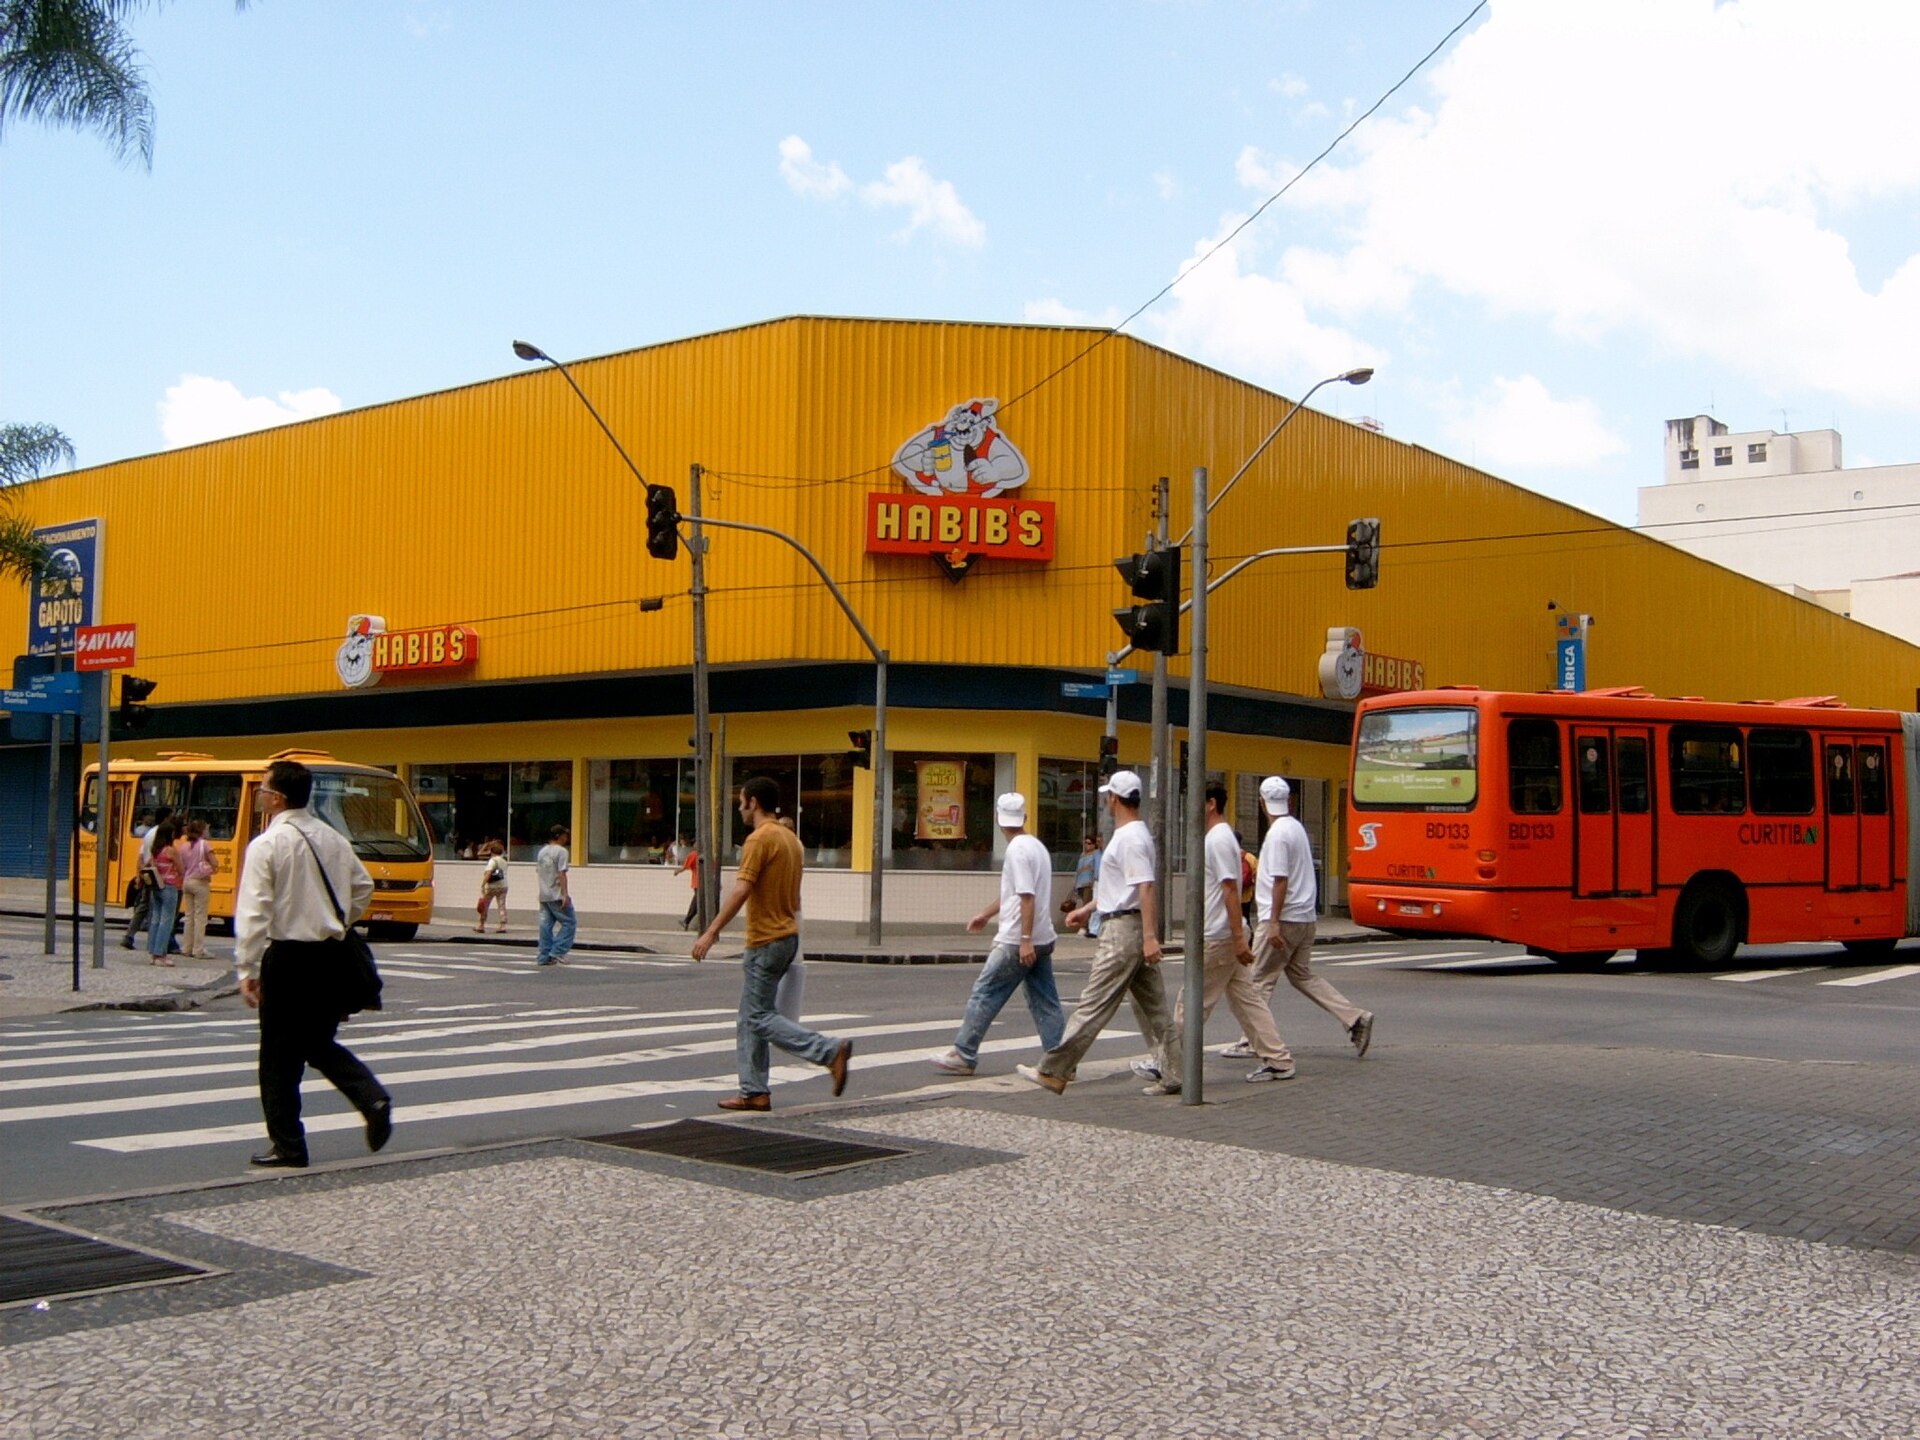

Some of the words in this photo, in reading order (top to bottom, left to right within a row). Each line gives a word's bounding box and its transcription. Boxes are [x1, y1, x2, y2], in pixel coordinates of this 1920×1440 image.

[877, 503, 1042, 546] HABIB'S
[39, 598, 82, 629] GAROTO
[78, 630, 135, 652] SAVINA
[375, 629, 464, 667] HABIB'S
[1563, 645, 1575, 689] ÉRICA
[1426, 822, 1470, 840] BD133
[1508, 823, 1555, 840] BD133
